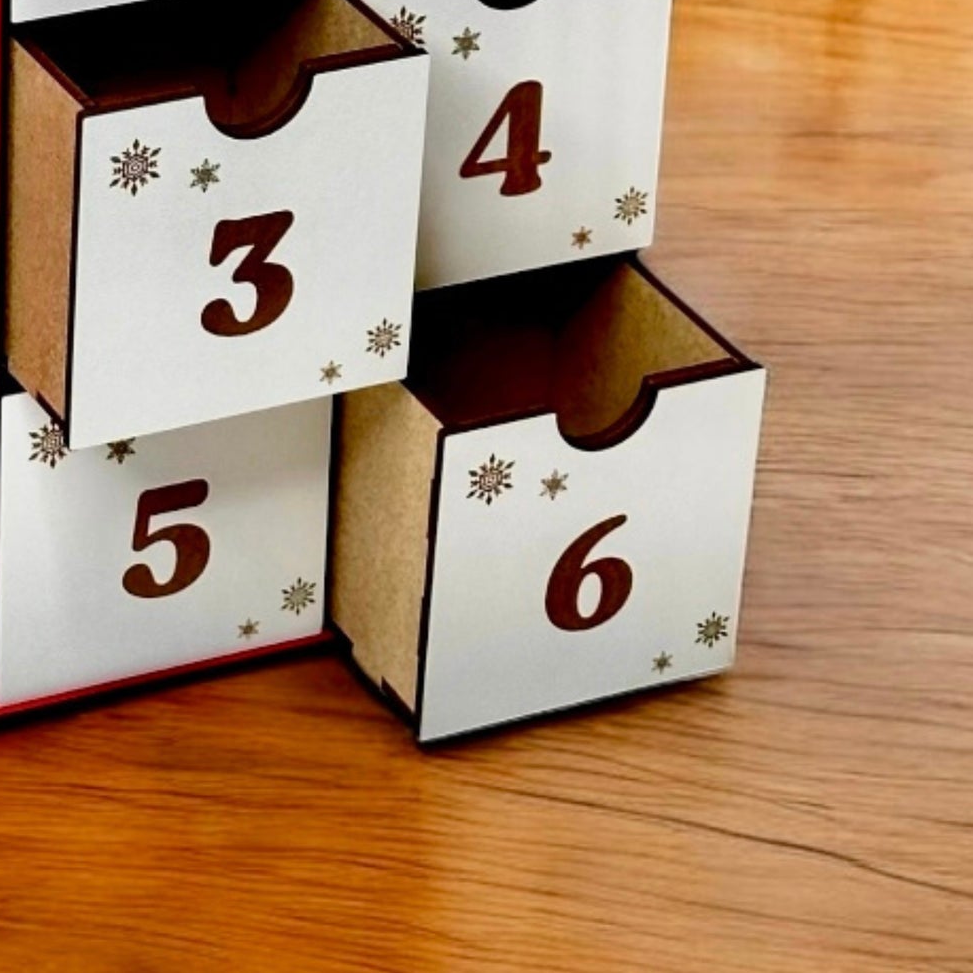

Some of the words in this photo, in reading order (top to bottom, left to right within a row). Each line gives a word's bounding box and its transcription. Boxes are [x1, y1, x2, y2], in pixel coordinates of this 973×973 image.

[459, 80, 552, 197] 4
[201, 209, 295, 338] 3
[123, 478, 211, 599] 5
[545, 514, 633, 632] 6
